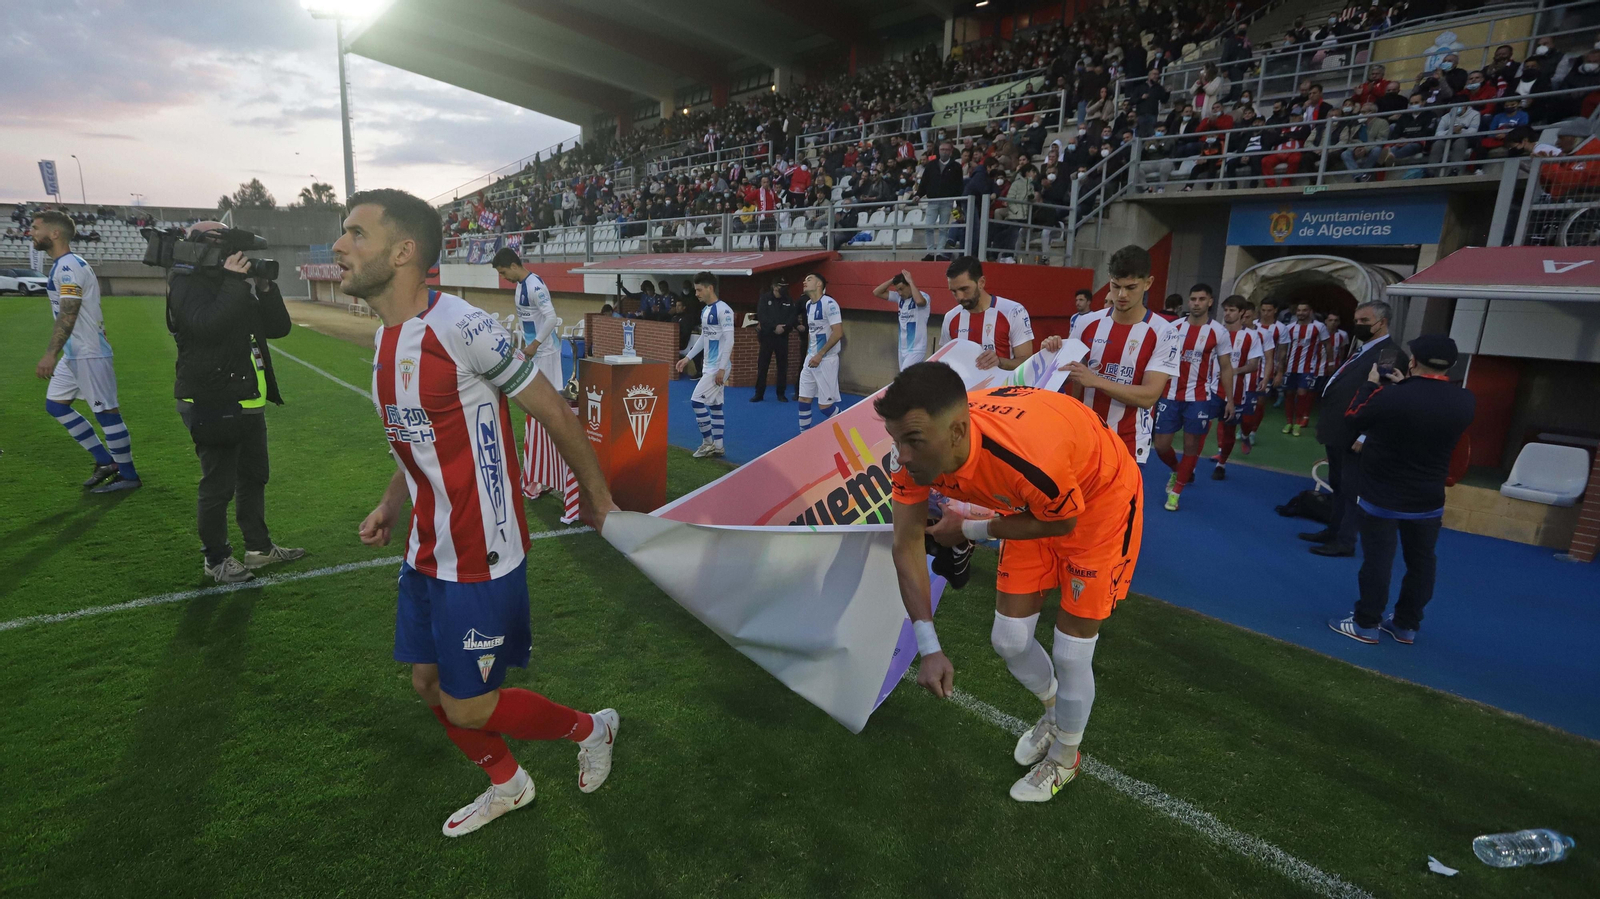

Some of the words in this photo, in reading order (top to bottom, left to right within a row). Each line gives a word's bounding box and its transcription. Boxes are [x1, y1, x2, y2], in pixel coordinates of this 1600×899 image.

[45, 161, 57, 193] IVECO
[1301, 210, 1395, 225] Ayuntamiento
[1298, 226, 1315, 237] de
[1316, 222, 1392, 239] Algeciras
[455, 319, 467, 329] Bar
[385, 405, 432, 427] 威视
[480, 420, 502, 509] ZPMC
